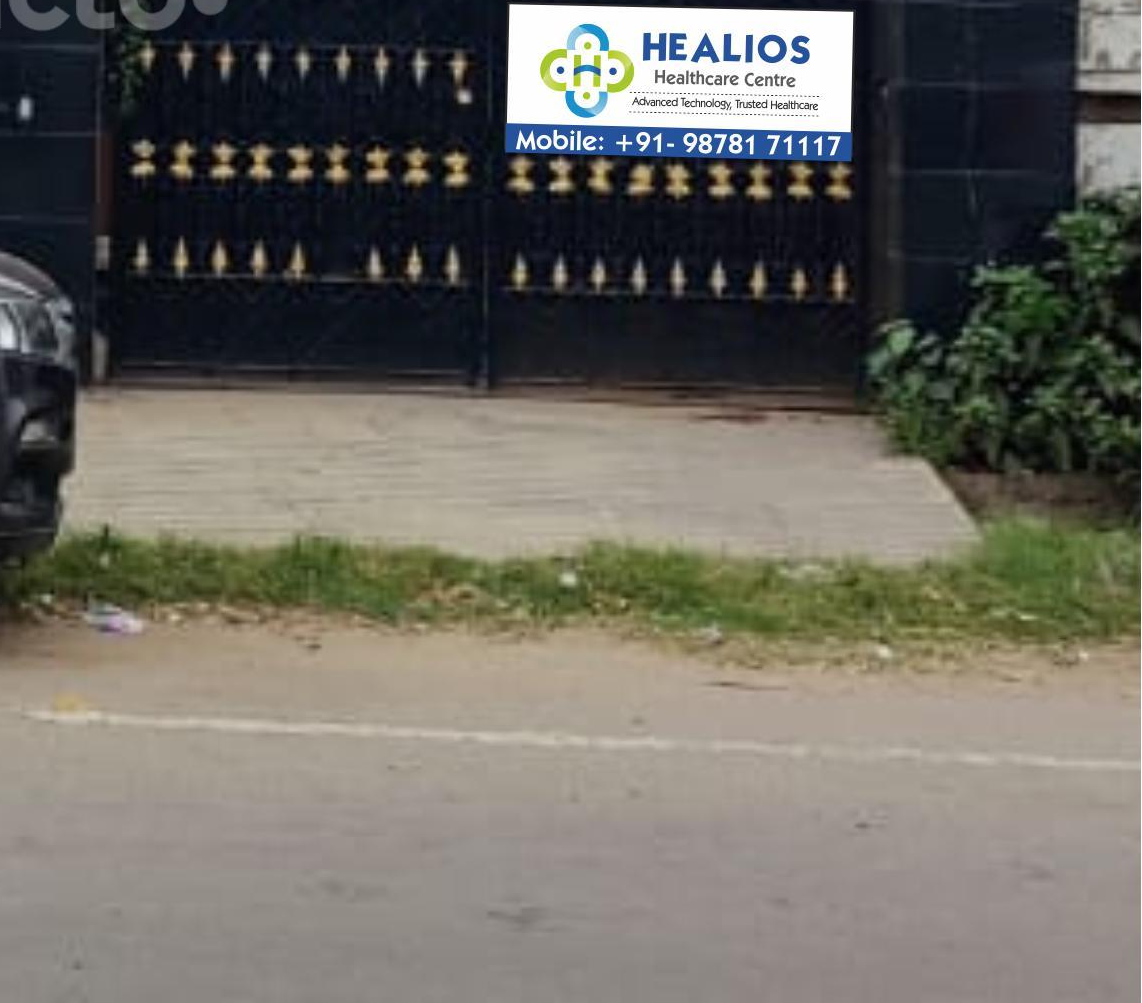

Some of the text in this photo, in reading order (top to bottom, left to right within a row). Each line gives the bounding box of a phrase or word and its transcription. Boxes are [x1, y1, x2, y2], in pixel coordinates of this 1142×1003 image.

[642, 32, 811, 65] HEALIOS
[654, 69, 796, 88] Healthcare Centre
[631, 96, 819, 111] Advanced Technology, Trusted Healthcare
[516, 129, 841, 156] Mobile: +91- 98781 71117
